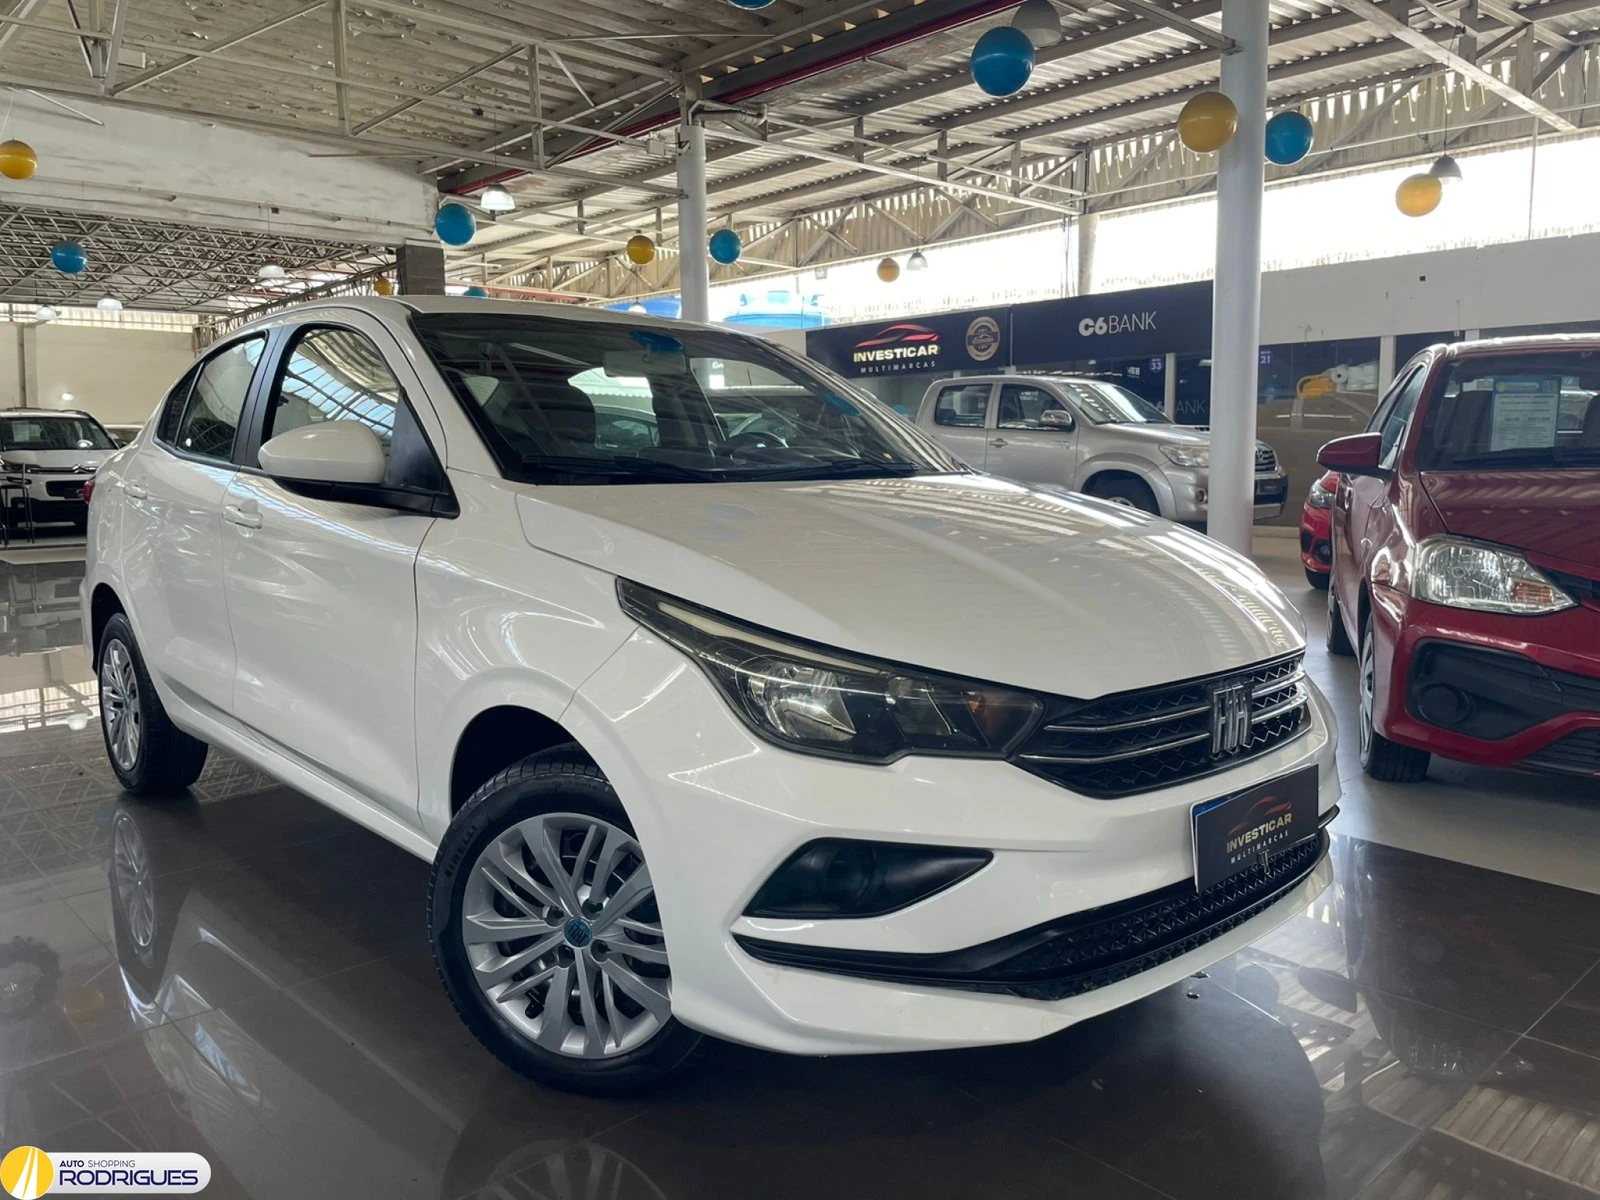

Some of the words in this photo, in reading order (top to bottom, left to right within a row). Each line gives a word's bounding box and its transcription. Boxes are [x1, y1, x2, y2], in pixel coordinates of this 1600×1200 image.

[853, 344, 938, 363] INVESTICAR
[1260, 355, 1271, 365] 21
[861, 361, 936, 373] MULTIMARCAS
[1175, 400, 1206, 415] ANK
[1226, 813, 1293, 854] INVESTICAR
[1230, 829, 1289, 864] MULTIMARCAS
